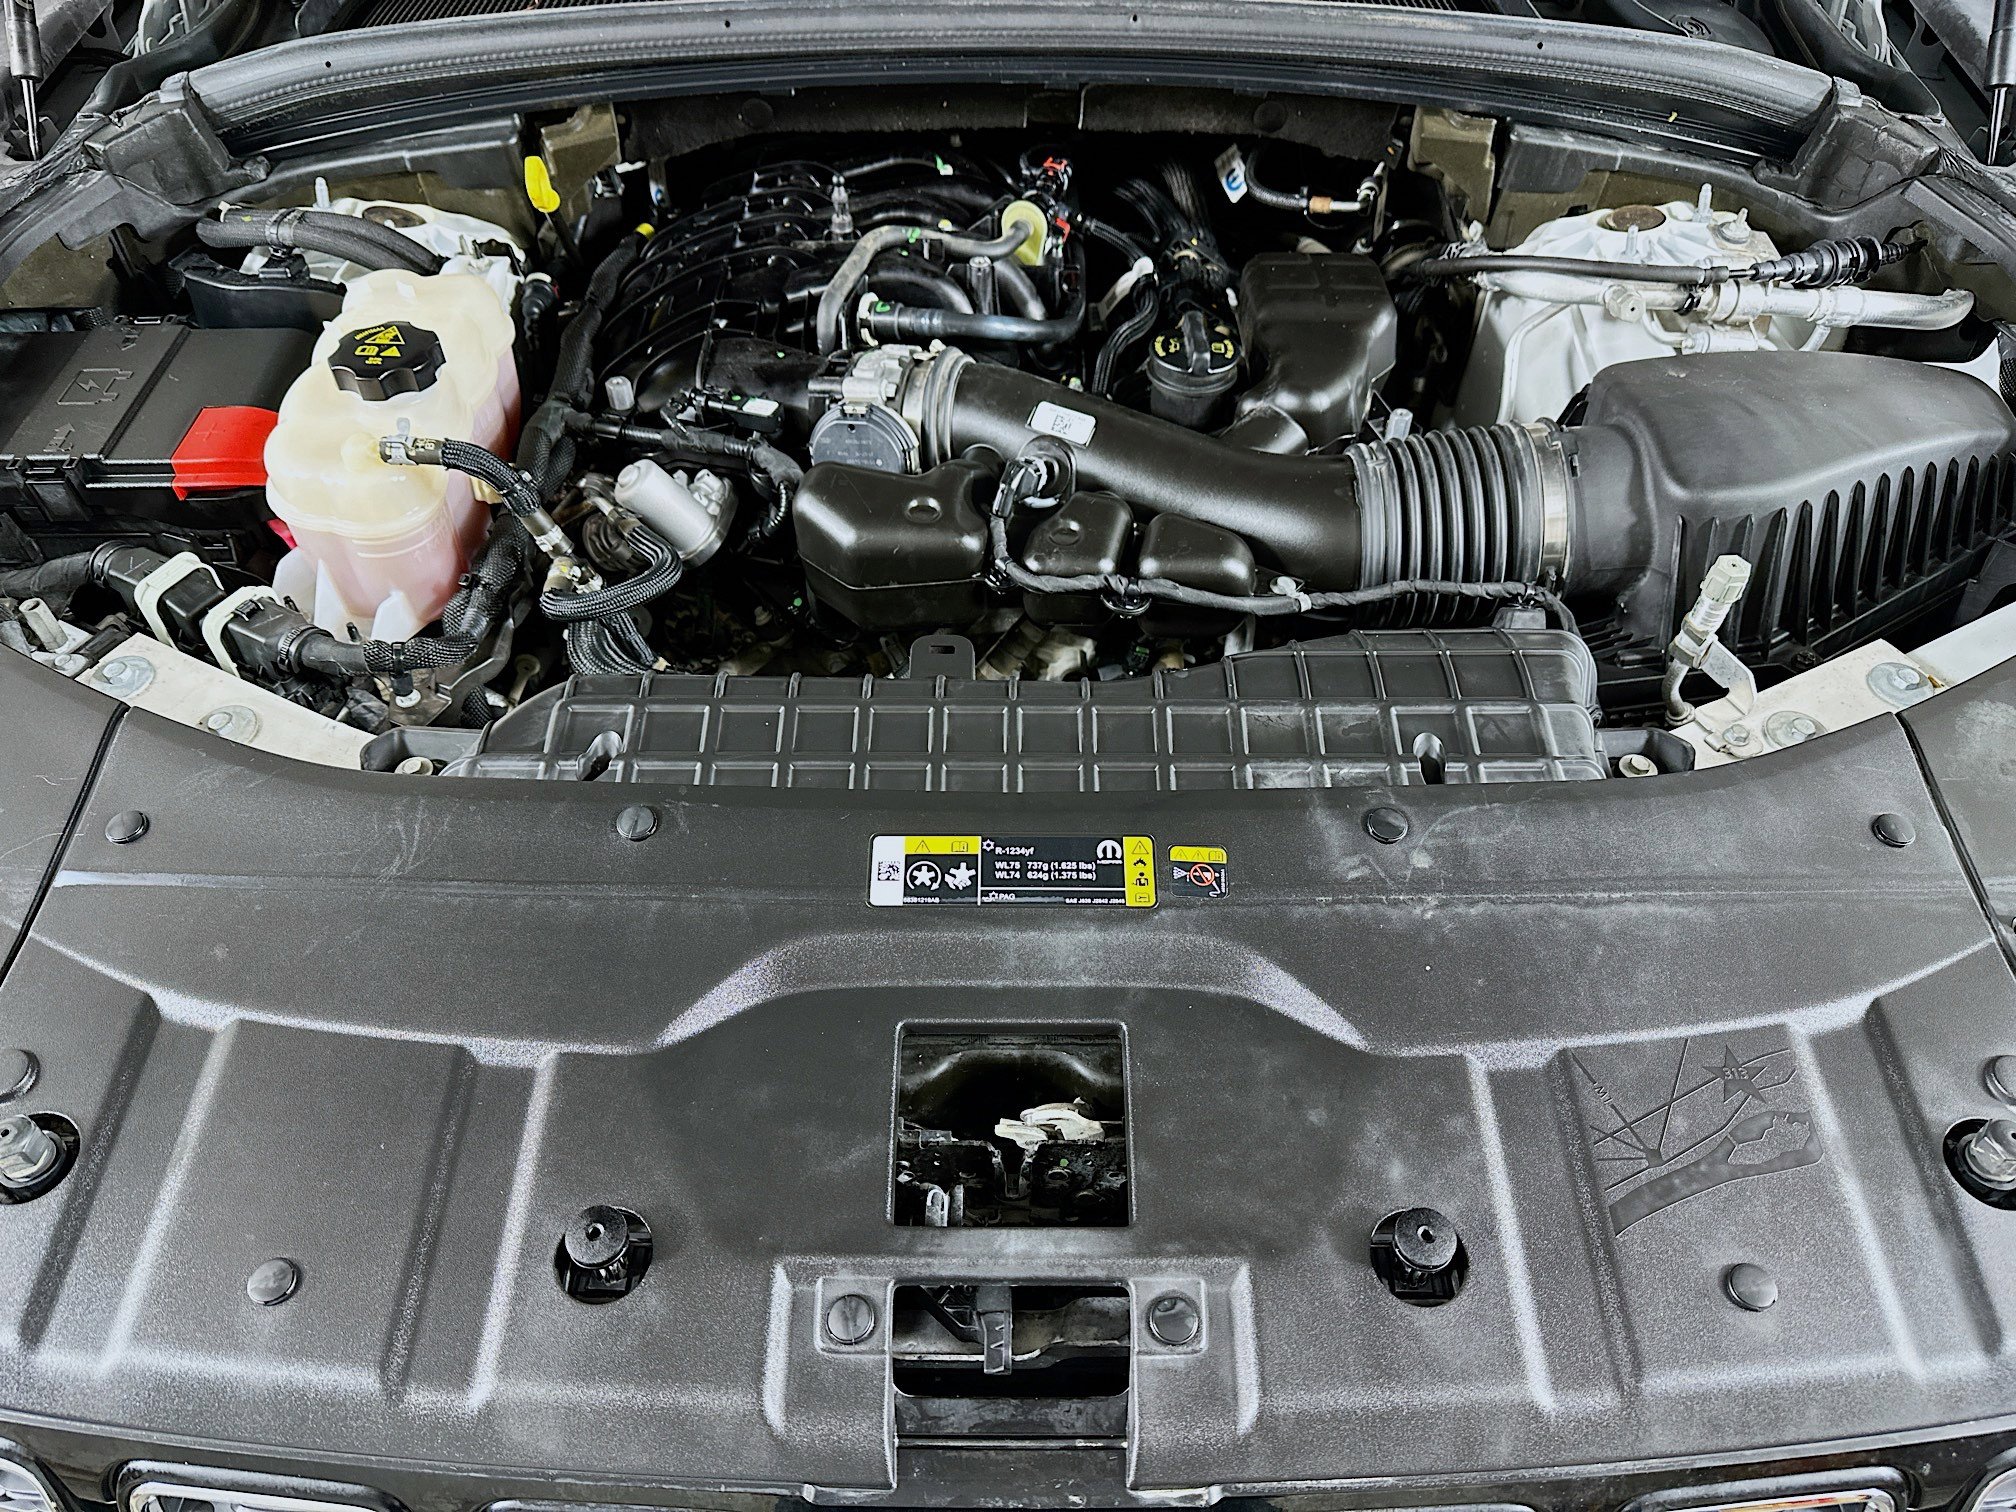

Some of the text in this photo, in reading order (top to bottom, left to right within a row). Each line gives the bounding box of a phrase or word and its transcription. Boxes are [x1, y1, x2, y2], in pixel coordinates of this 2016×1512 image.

[994, 846, 1035, 857] R-1234yf
[994, 861, 1097, 872] WL75 737g (1.625 lbs)
[994, 870, 1097, 881] WL74 624g (1.375 lbs)
[998, 893, 1016, 901] PAG
[1722, 1067, 1750, 1080] 313
